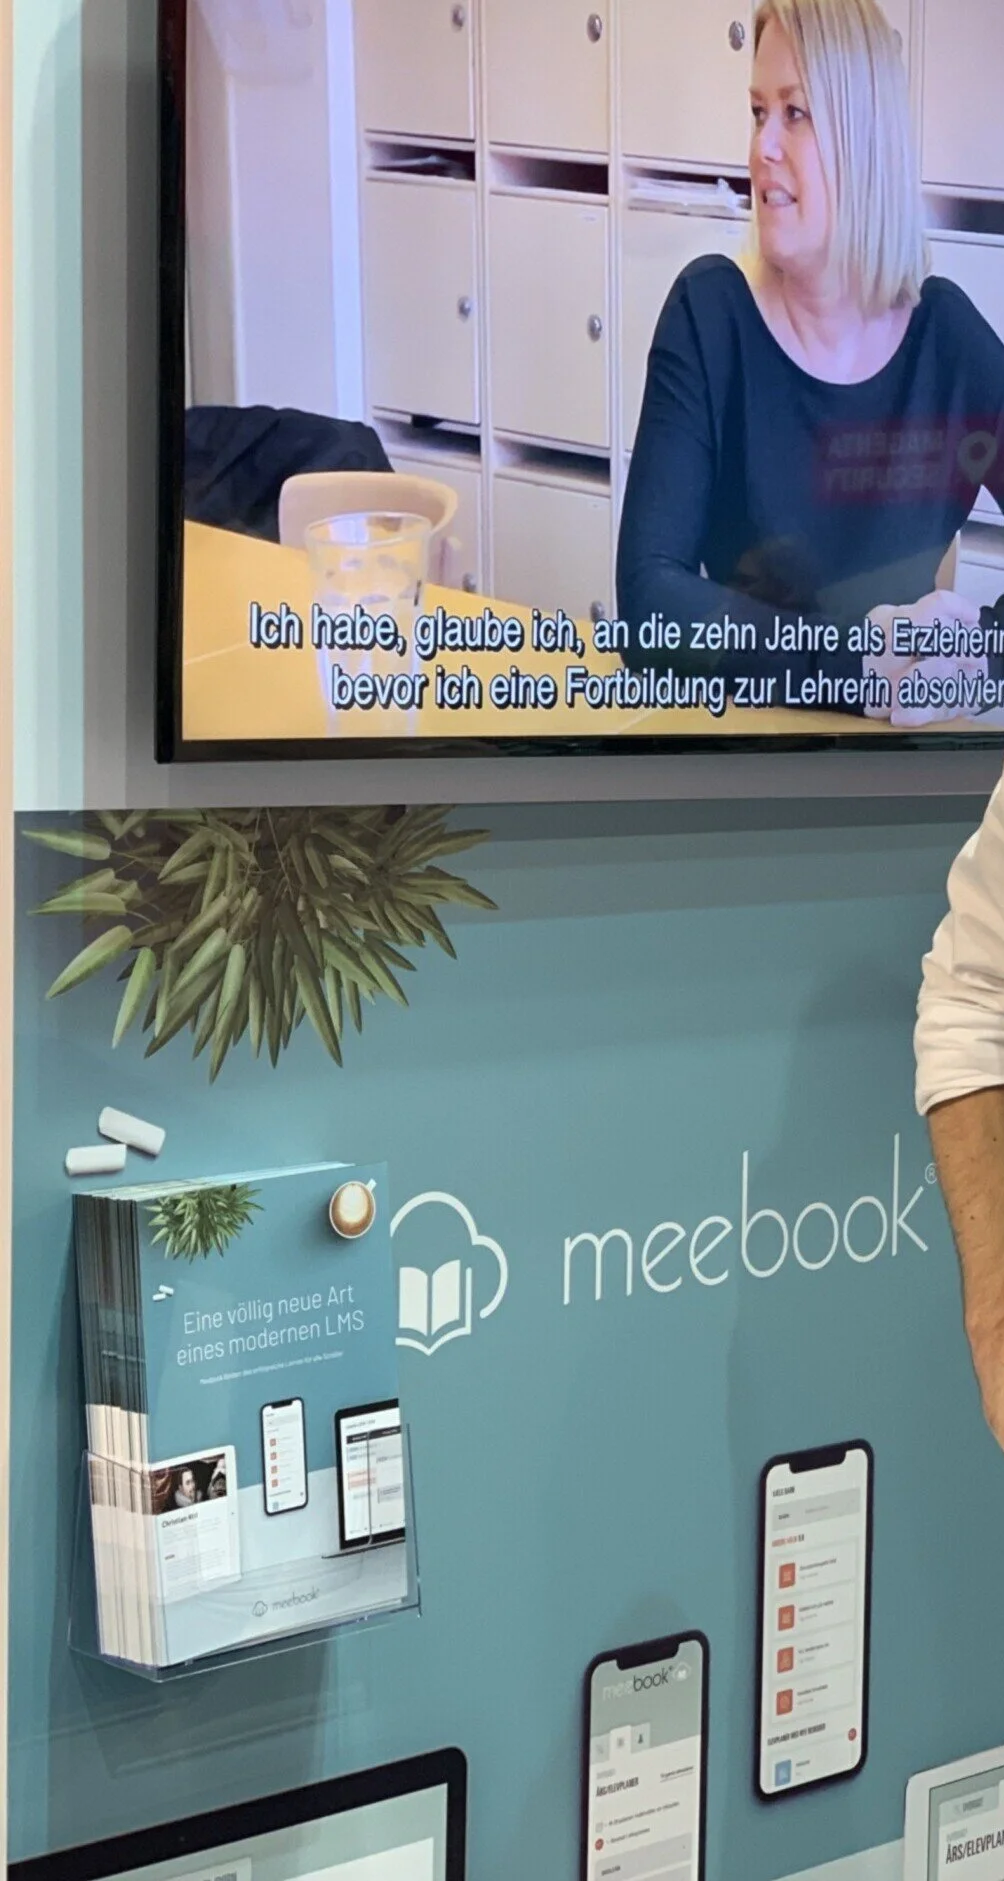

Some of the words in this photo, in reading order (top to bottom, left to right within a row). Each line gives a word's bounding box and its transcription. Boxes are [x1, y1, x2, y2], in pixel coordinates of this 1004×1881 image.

[250, 602, 299, 647] Ich
[312, 603, 406, 654] habe,
[415, 606, 523, 659] glaube
[532, 609, 585, 655] ich,
[594, 621, 629, 650] an
[639, 612, 680, 650] die
[690, 615, 757, 651] zehn
[765, 616, 839, 653] Jahre
[848, 617, 884, 654] als
[333, 665, 427, 709] bevor
[436, 666, 481, 708] ich
[490, 667, 557, 708] eine
[566, 667, 725, 716] Fortbildung
[733, 676, 777, 704] zur
[785, 669, 890, 706] Lehrerin
[183, 1311, 223, 1335] Eine
[227, 1299, 273, 1323] völlig
[278, 1292, 322, 1315] neue
[327, 1285, 355, 1306] Art
[176, 1341, 225, 1366] eines
[229, 1322, 321, 1354] modernen
[325, 1310, 365, 1336] LMS
